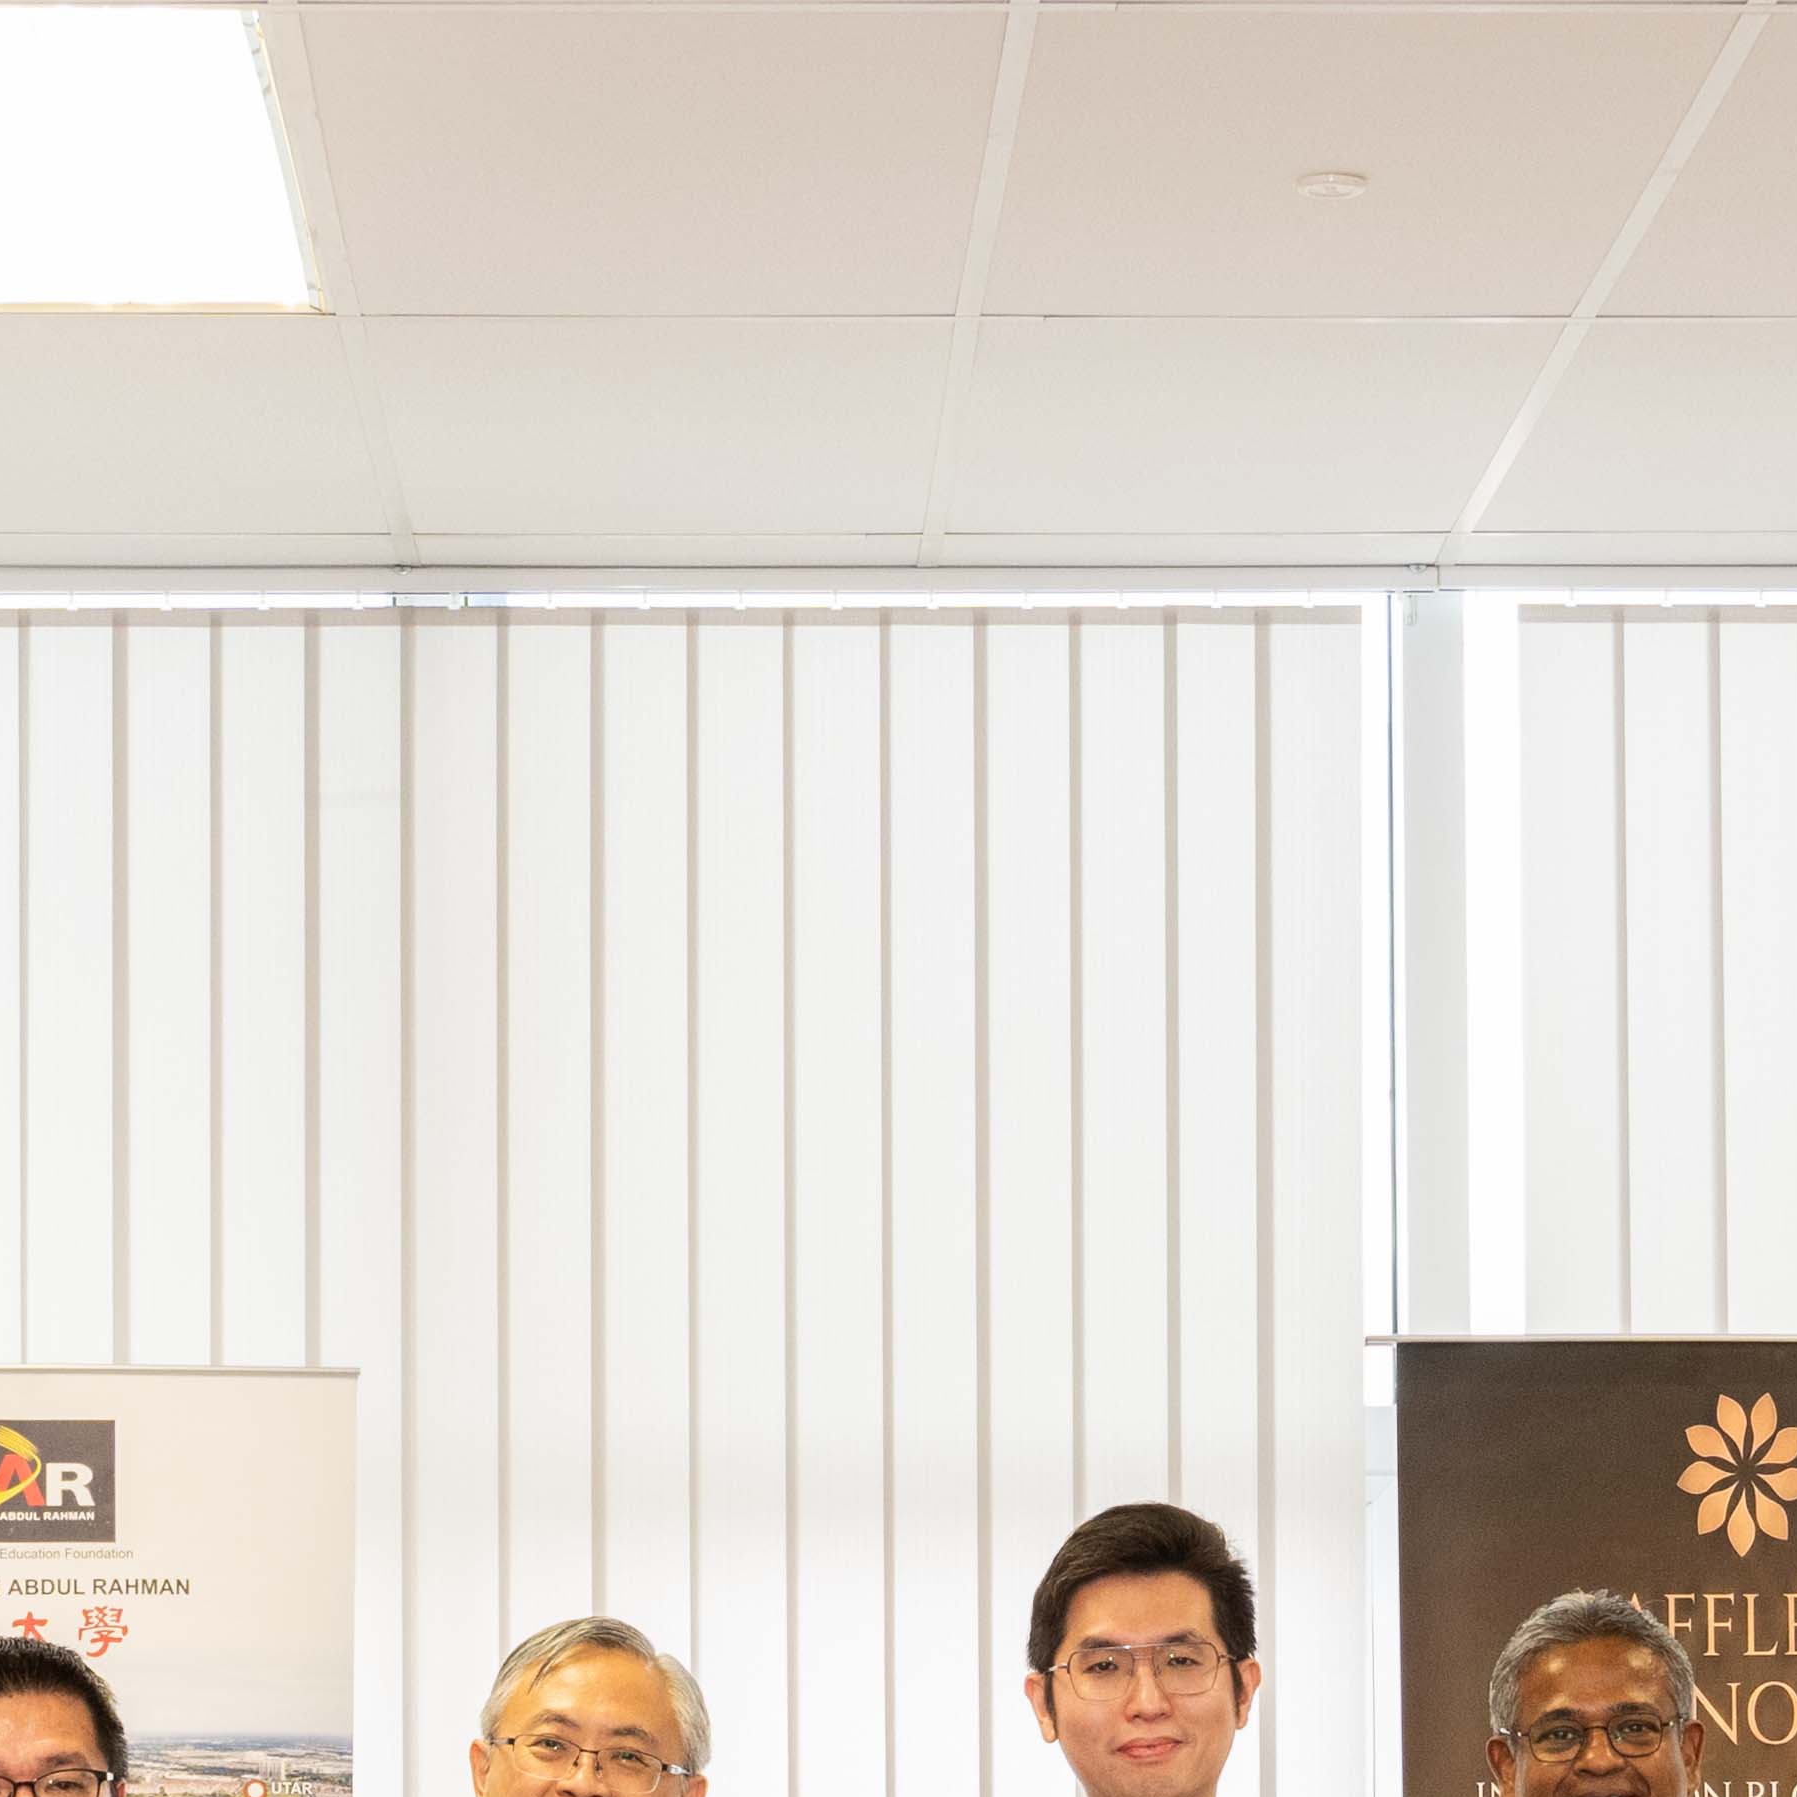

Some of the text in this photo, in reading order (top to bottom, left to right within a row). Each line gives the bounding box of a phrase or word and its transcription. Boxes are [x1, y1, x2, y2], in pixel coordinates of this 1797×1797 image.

[0, 1512, 40, 1521] ABDUL
[43, 1511, 95, 1520] RAHMAN
[0, 1548, 60, 1560] Education
[65, 1548, 133, 1559] Foundation
[8, 1579, 85, 1595] ABDUL
[93, 1579, 189, 1595] RAHMAN
[272, 1783, 312, 1794] UTAR
